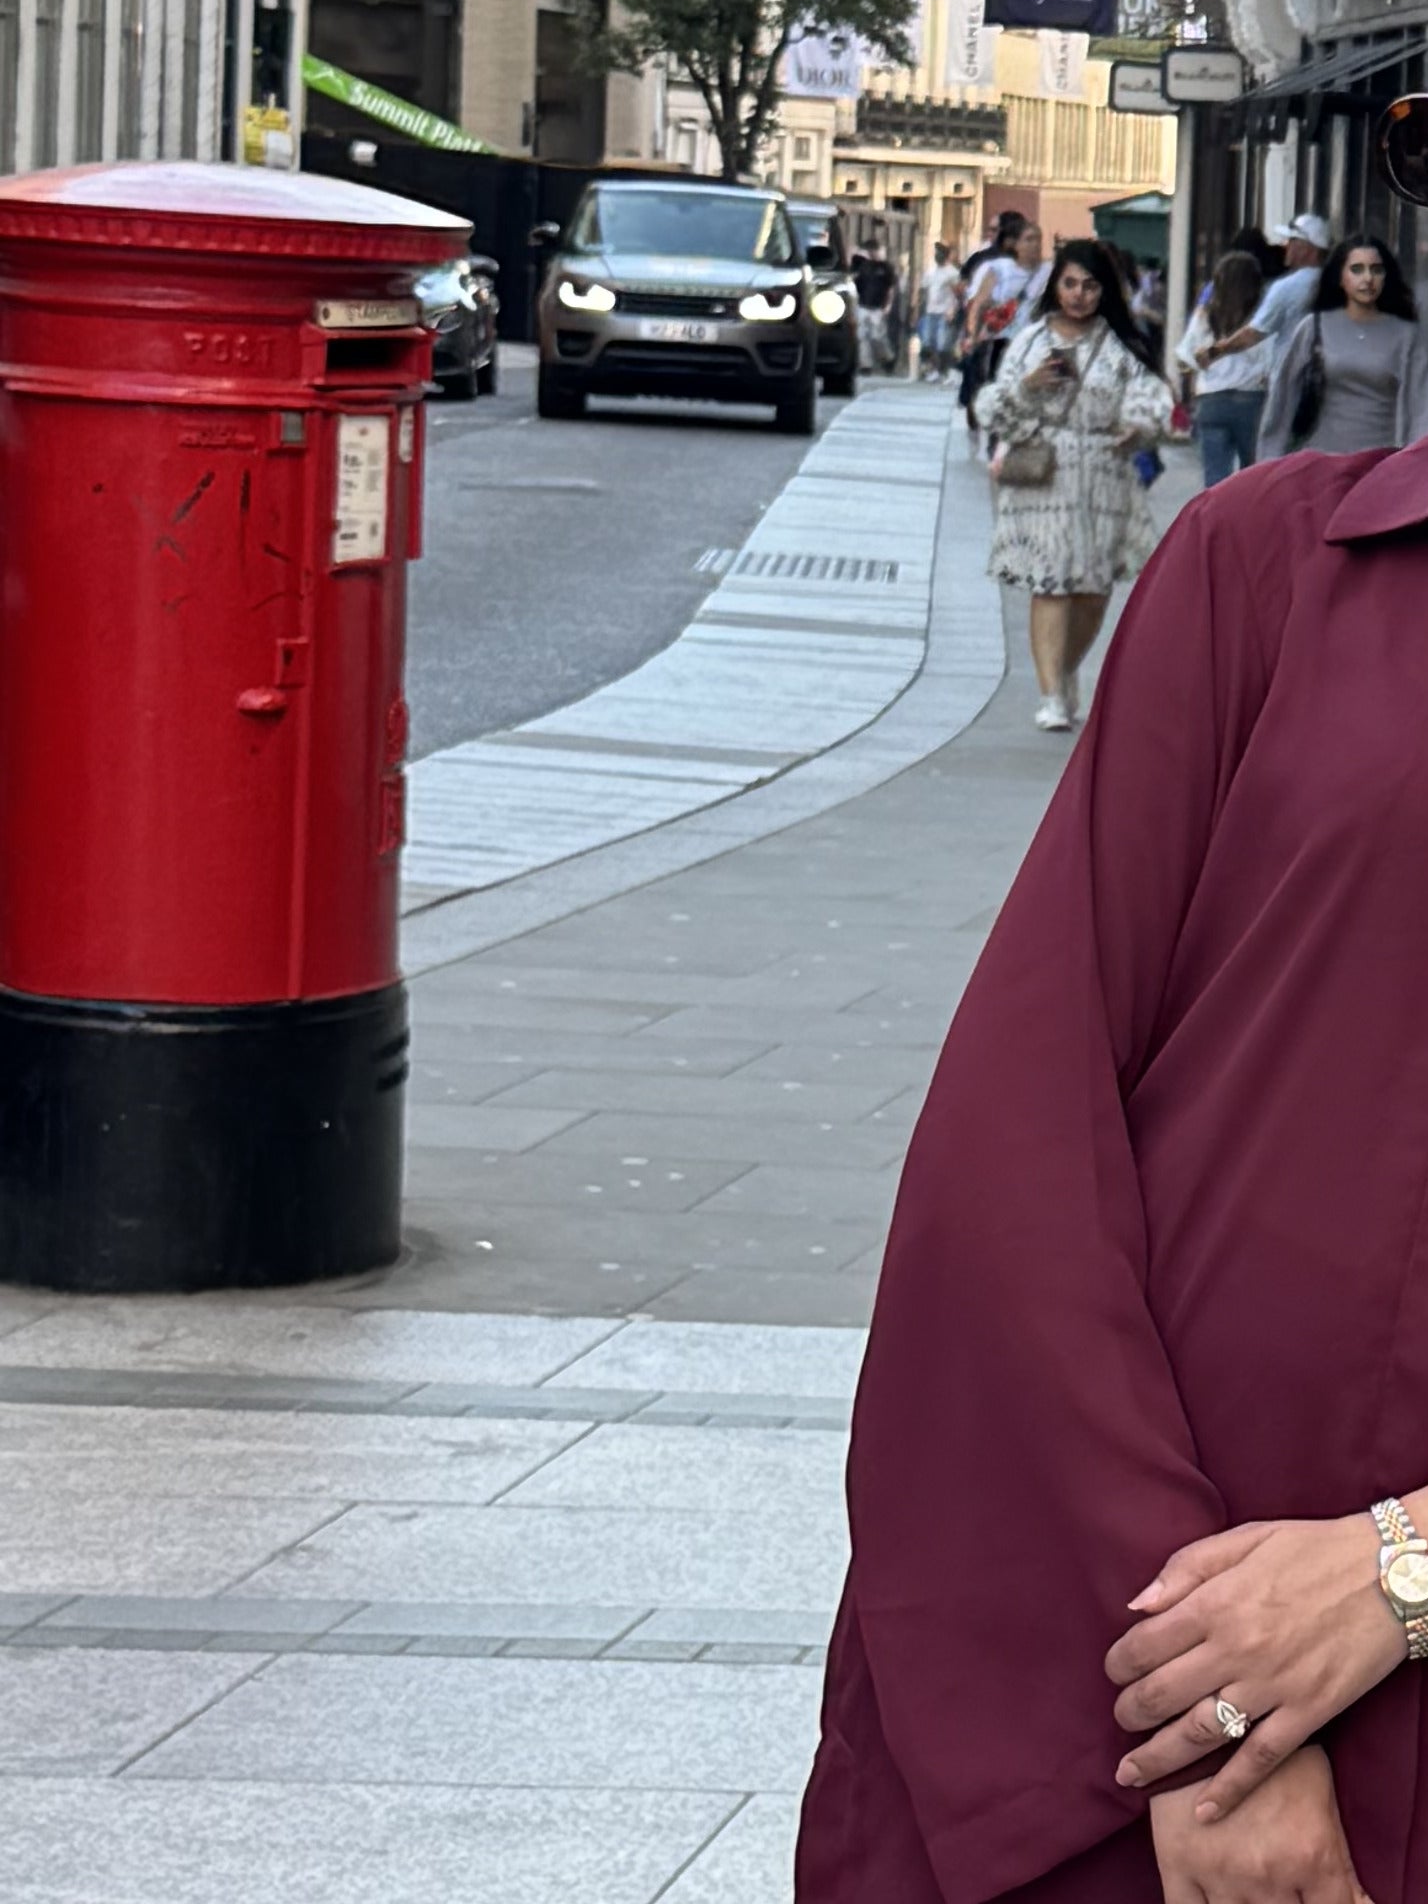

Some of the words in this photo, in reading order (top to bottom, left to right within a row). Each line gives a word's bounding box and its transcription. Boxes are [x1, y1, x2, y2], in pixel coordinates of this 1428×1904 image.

[965, 4, 981, 78] CHANEL
[797, 66, 850, 87] DIOR
[350, 79, 429, 137] Summit
